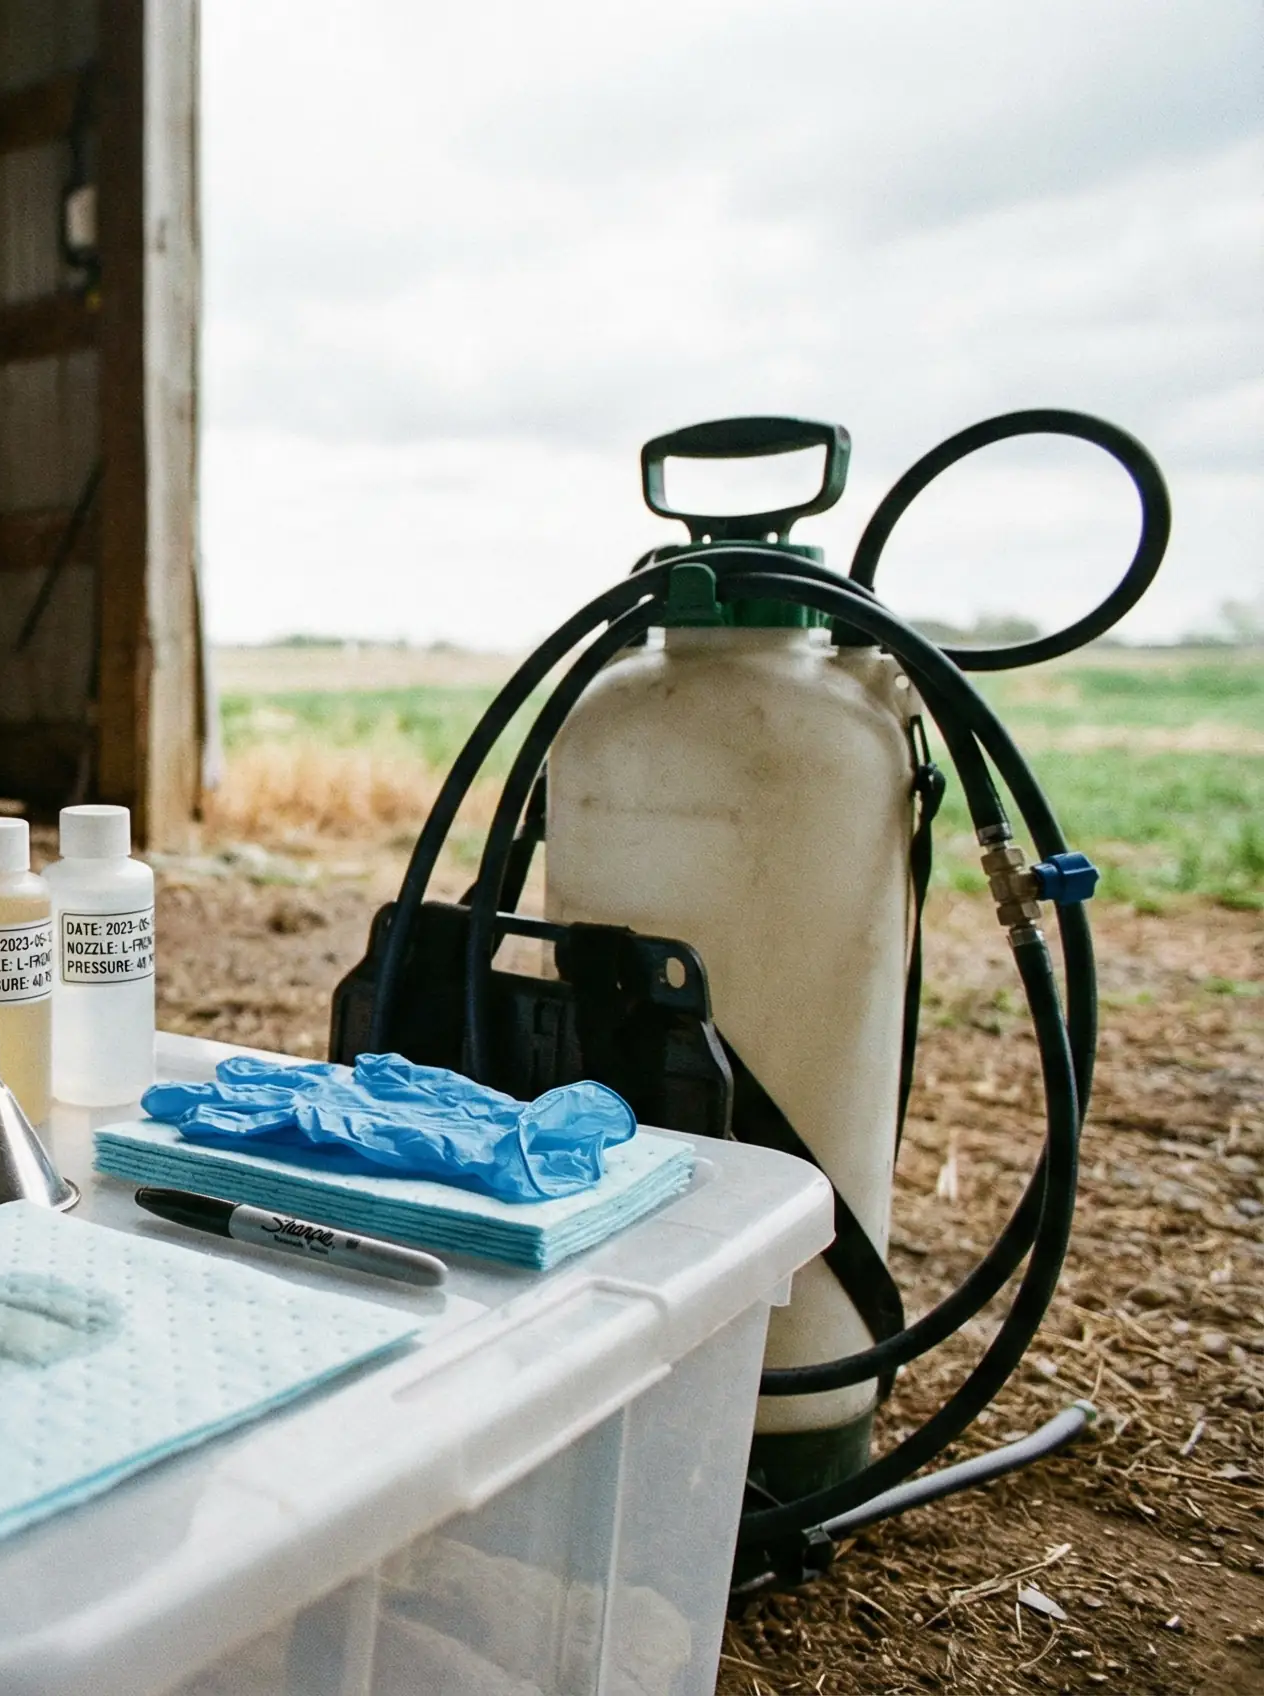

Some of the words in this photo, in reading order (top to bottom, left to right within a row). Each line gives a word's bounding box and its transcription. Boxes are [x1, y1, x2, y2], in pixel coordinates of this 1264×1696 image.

[67, 921, 102, 936] DATE:
[67, 941, 118, 955] NOZZLE:
[67, 959, 134, 974] PRESSURE:
